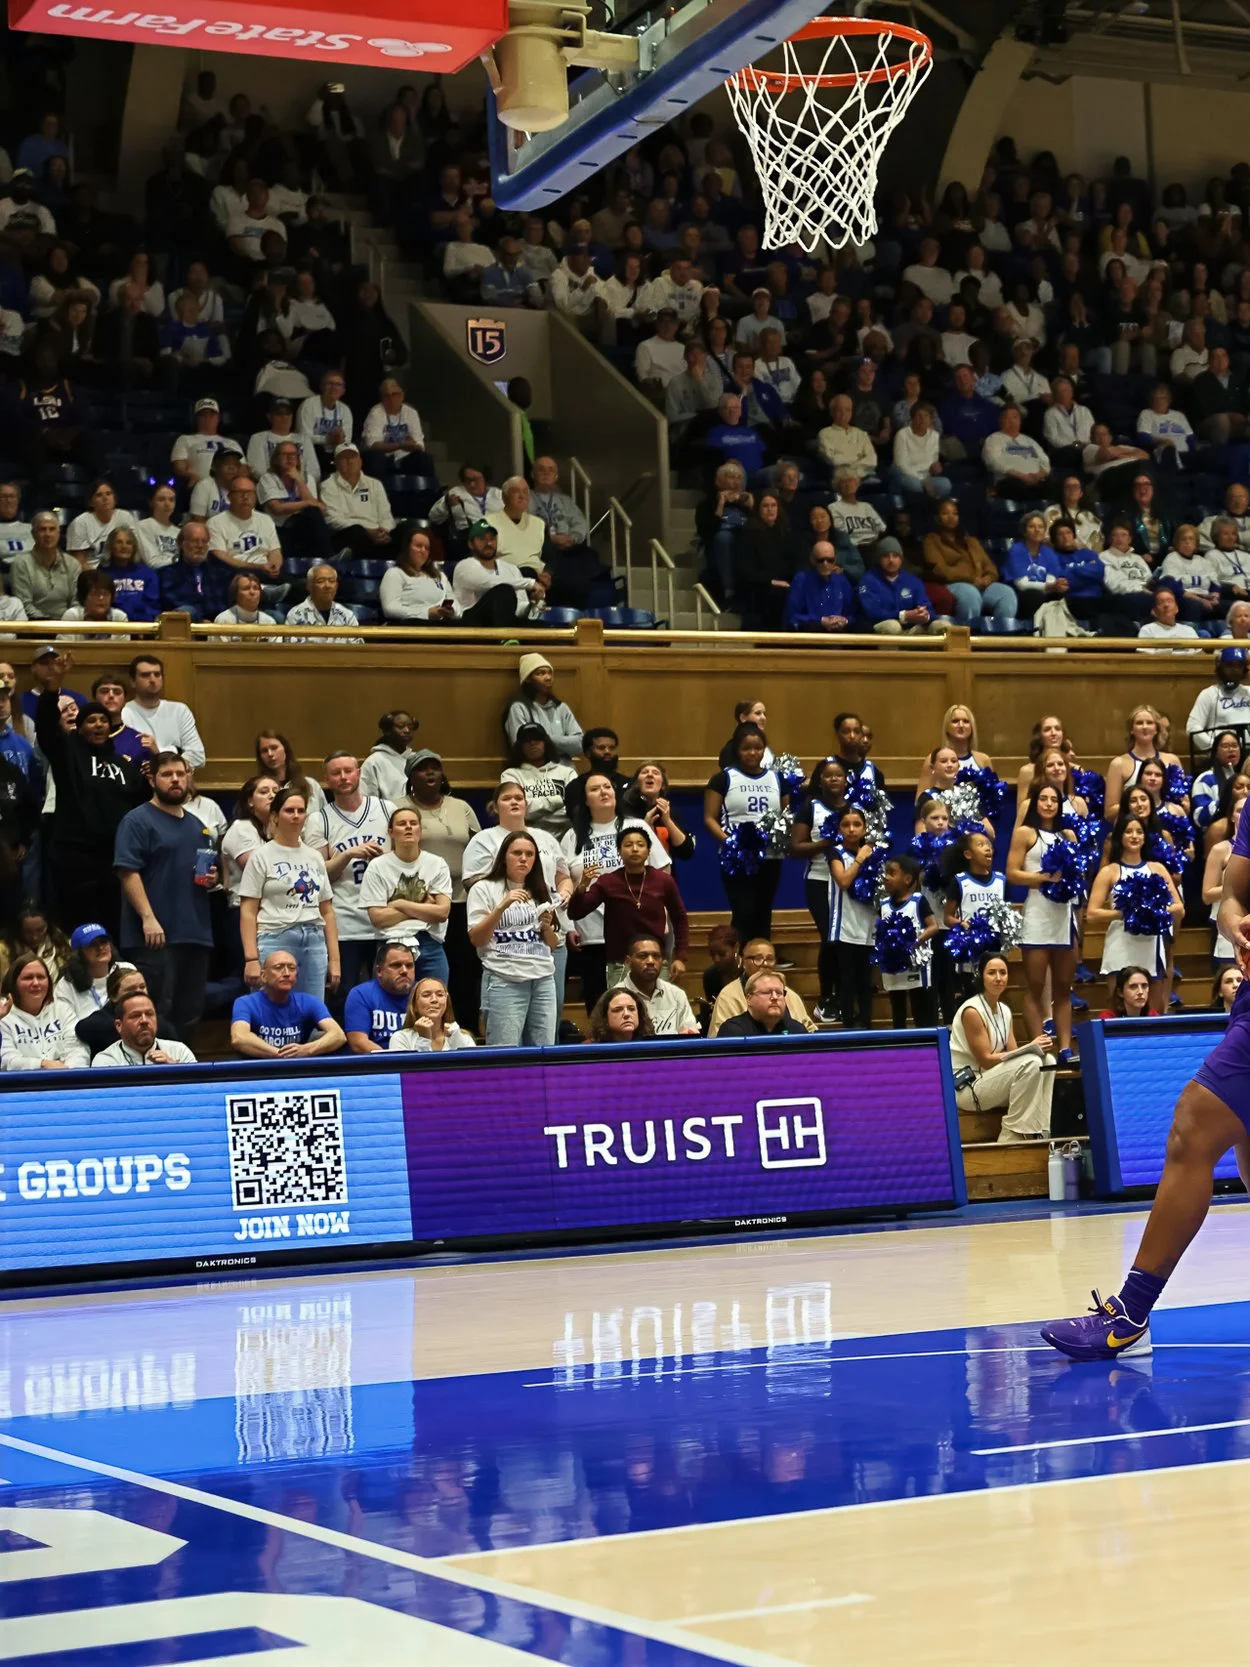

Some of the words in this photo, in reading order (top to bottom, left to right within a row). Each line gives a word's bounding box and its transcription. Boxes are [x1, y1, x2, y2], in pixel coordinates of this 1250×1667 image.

[475, 330, 501, 355] 15
[1221, 697, 1250, 709] Duke
[533, 789, 556, 798] FACE
[740, 785, 772, 793] DUKE
[748, 797, 768, 813] 26
[259, 1025, 270, 1036] GO
[271, 1027, 282, 1037] TO
[283, 1026, 301, 1036] HELL
[543, 1115, 744, 1169] TRUIST
[18, 1152, 192, 1201] GROUPS
[233, 1214, 291, 1241] JOIN
[296, 1211, 350, 1237] NOW
[734, 1216, 788, 1226] DAKTRONICS
[195, 1256, 257, 1268] DAKTRONICS
